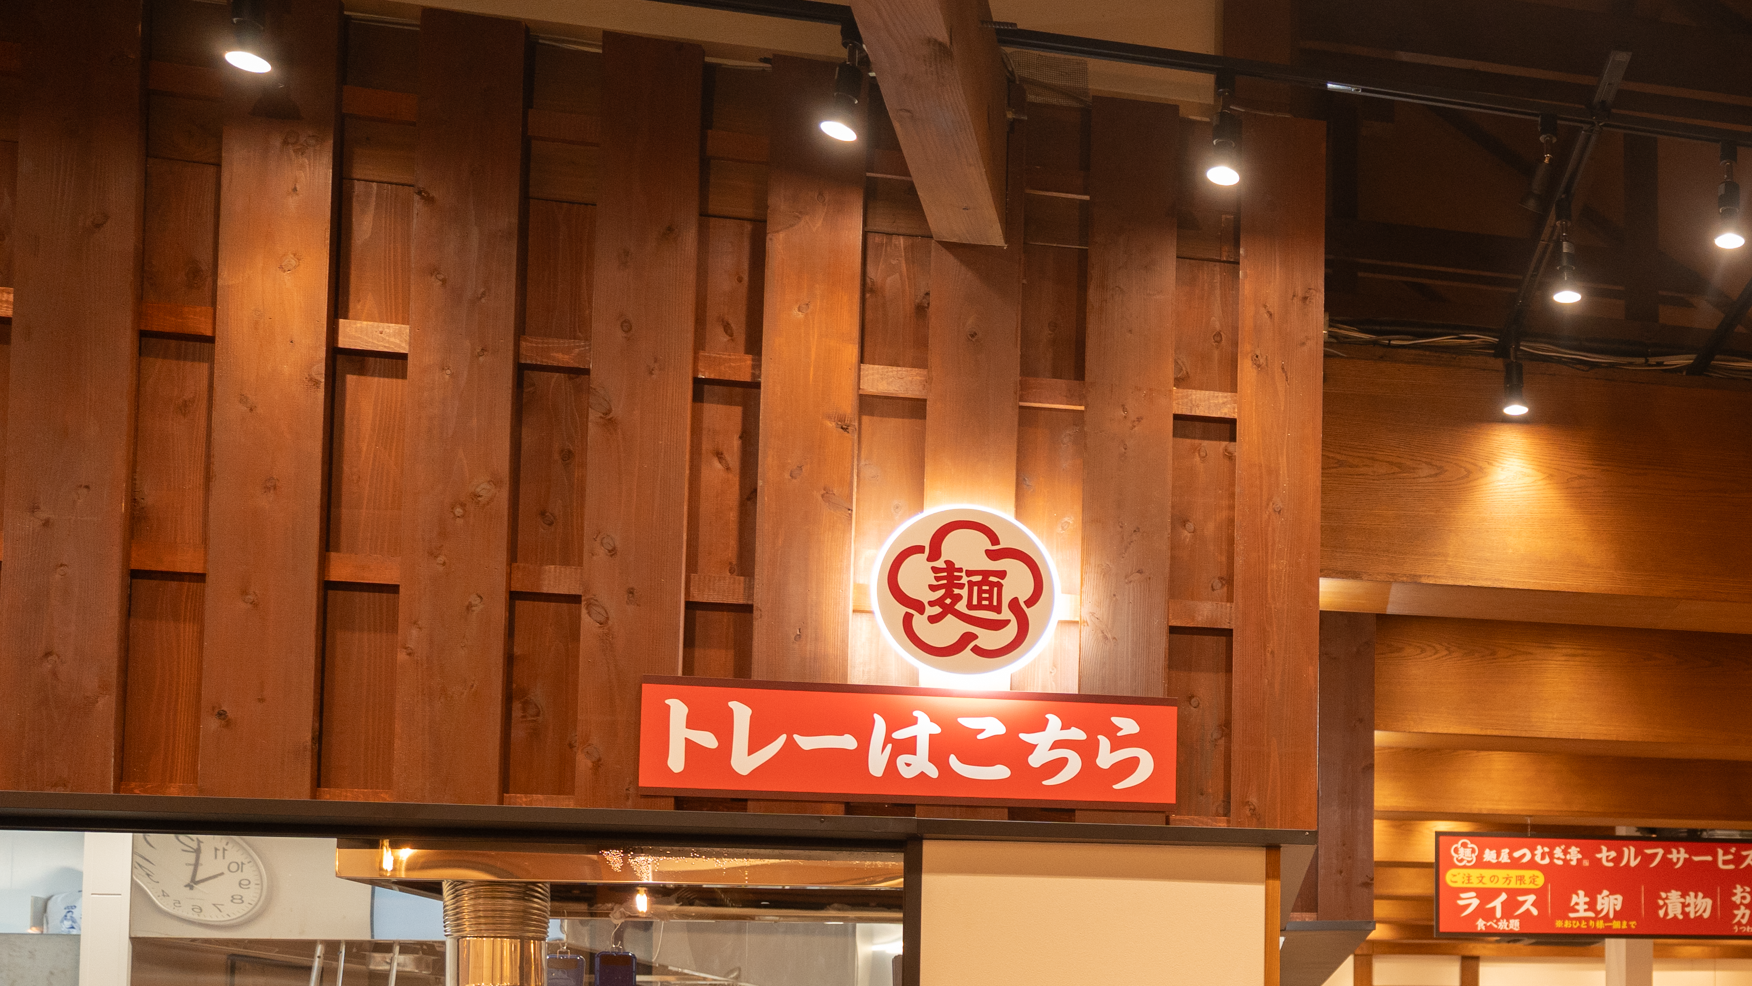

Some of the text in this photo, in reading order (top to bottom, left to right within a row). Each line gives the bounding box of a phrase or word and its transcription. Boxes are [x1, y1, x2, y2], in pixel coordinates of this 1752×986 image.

[927, 560, 1011, 631] 麺
[664, 698, 1154, 790] トレーはこちら
[1483, 845, 1583, 866] 麺屋つむぎ亭
[1449, 872, 1541, 887] ご注文の方限定
[1456, 891, 1539, 918] ライス
[1568, 890, 1623, 919] 生卵
[1657, 890, 1713, 919] 漬物
[1475, 918, 1521, 931] 食べ放題
